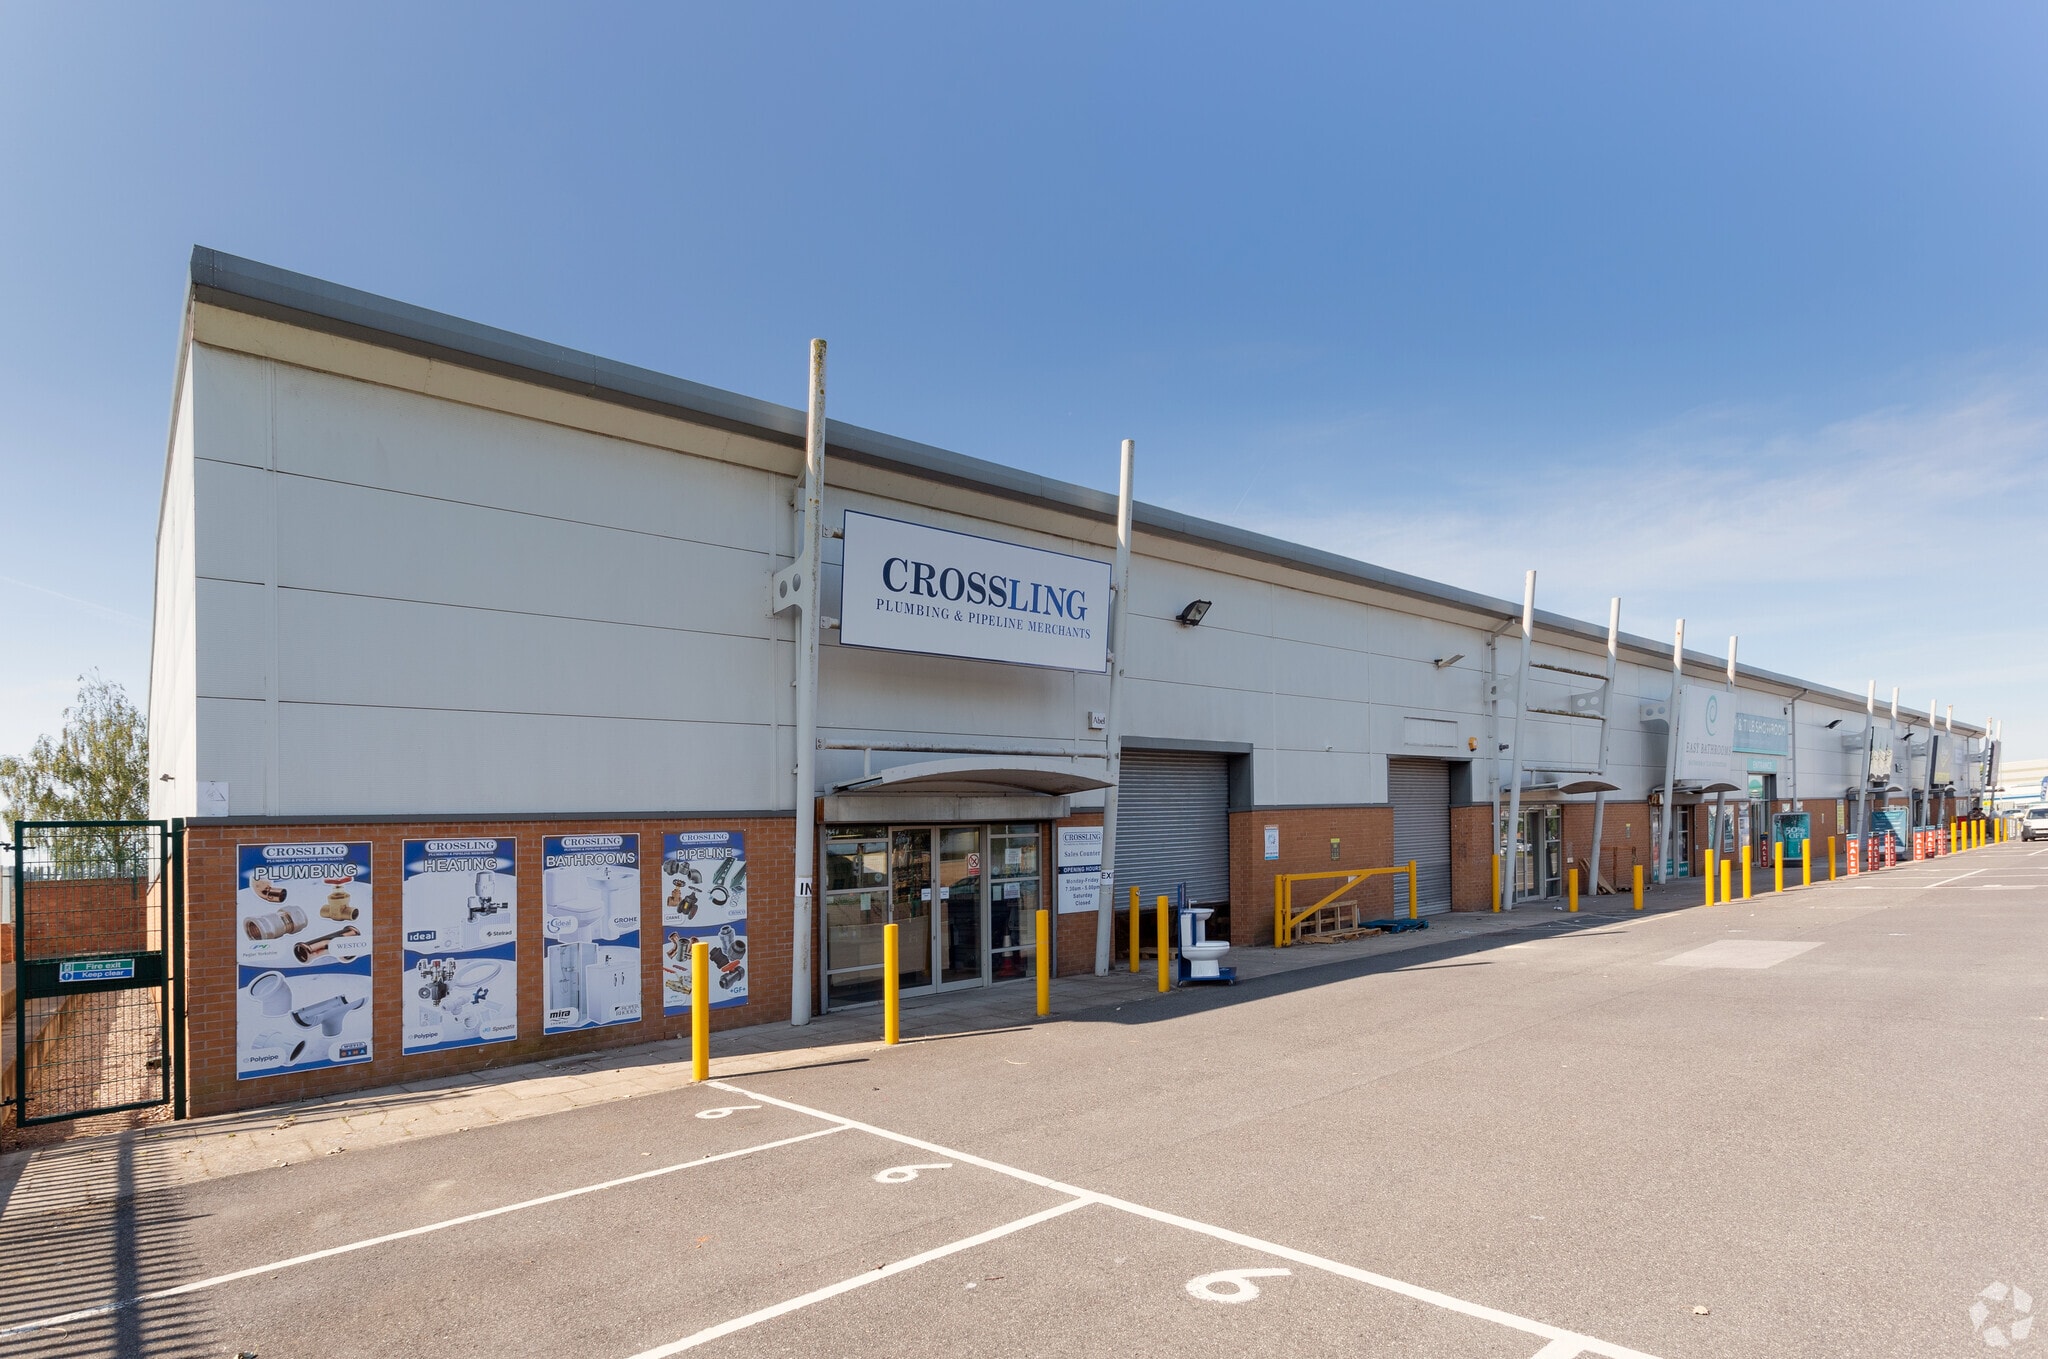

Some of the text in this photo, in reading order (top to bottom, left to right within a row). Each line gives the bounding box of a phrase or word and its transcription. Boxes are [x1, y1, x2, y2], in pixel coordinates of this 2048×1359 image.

[882, 557, 1088, 621] CROSSLING
[876, 598, 1091, 639] PLUMBING & PIPELINE MERCHANTS
[564, 837, 621, 846] CROSSLING
[681, 833, 728, 841] CROSSLING
[1064, 833, 1101, 841] CROSSLING
[266, 846, 344, 856] CROSSLING
[428, 841, 494, 850] CROSSLING
[546, 852, 636, 867] BATHROOMS
[677, 848, 732, 860] PIPELINE
[423, 857, 497, 872] HEATING
[254, 863, 358, 881] PLUMBING
[409, 932, 435, 941] ideal
[549, 1010, 571, 1019] mira
[413, 1031, 438, 1039] Polypipe
[250, 1053, 279, 1062] Polypipe
[695, 1105, 762, 1120] 6
[872, 1162, 953, 1184] 6
[1184, 1267, 1291, 1302] 6
